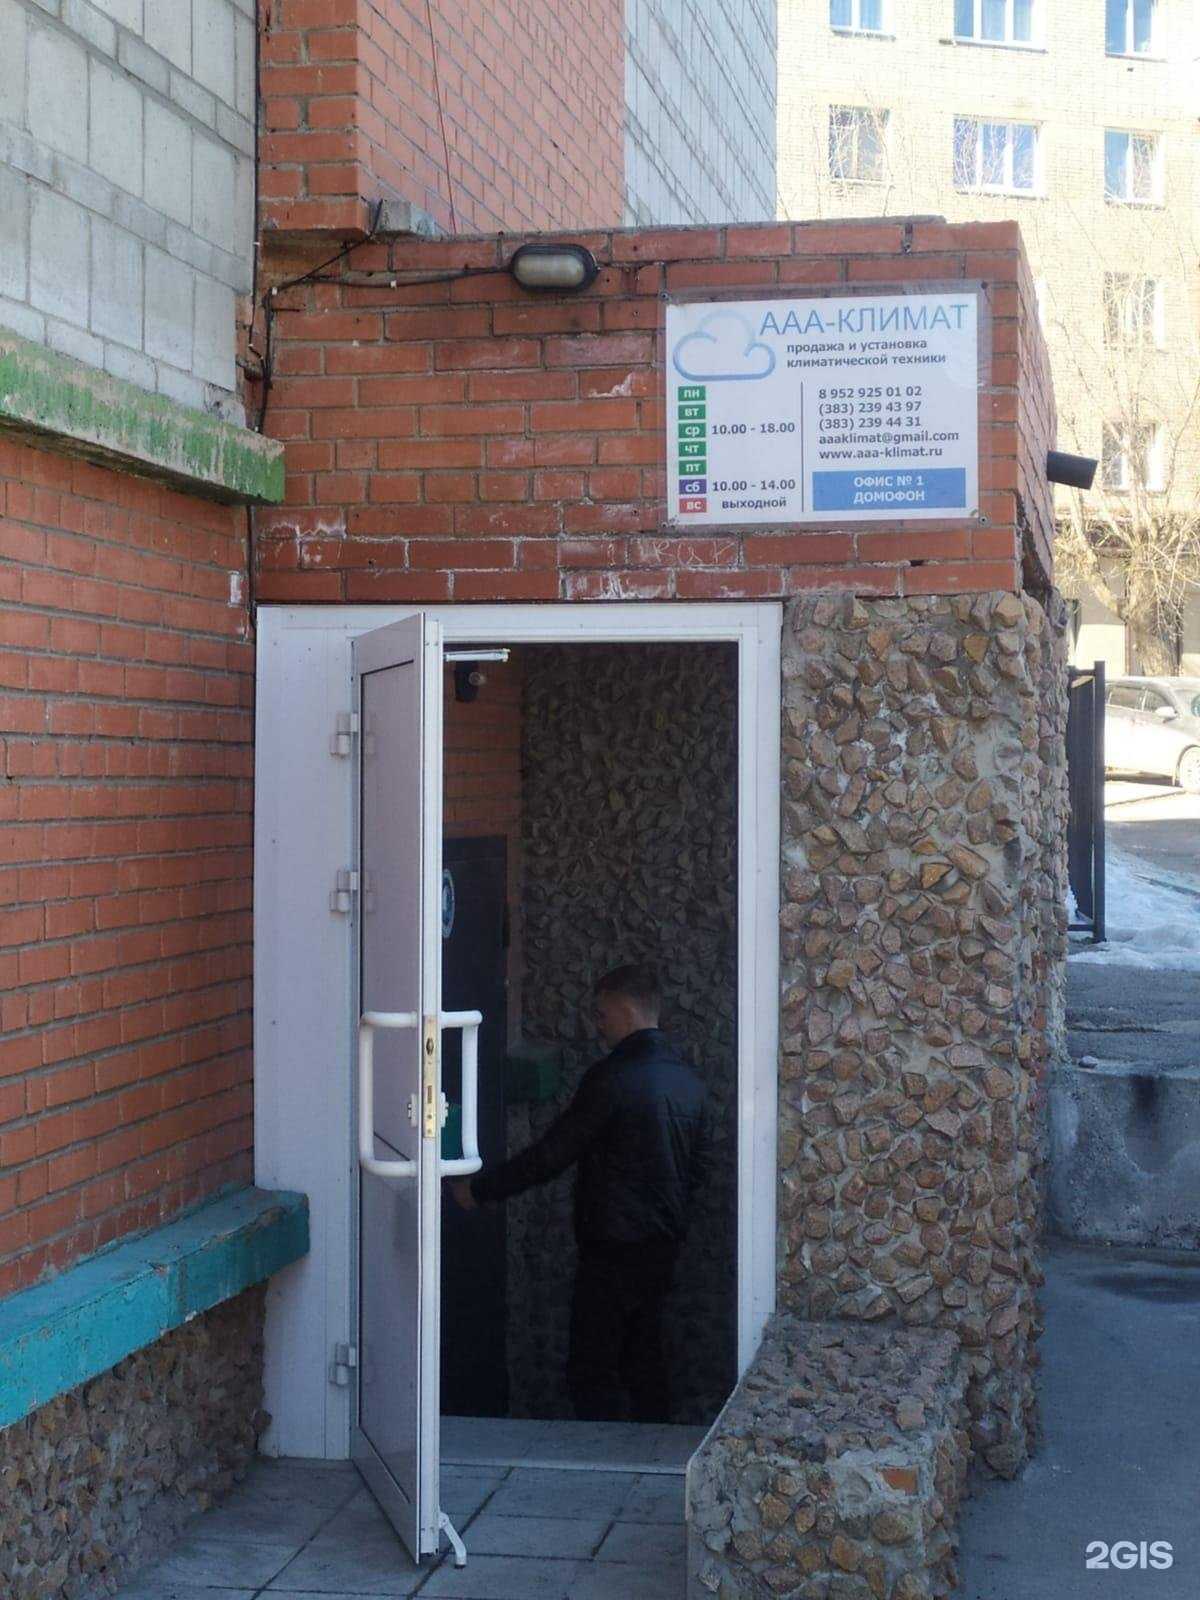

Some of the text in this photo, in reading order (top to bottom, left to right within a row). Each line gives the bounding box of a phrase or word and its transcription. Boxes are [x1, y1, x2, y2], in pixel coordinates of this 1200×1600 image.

[760, 304, 969, 336] ААА-КЛИМАТ
[787, 339, 928, 354] продажа и установка
[787, 354, 946, 368] климатической техники
[683, 389, 700, 399] пн
[819, 386, 922, 399] 8 952 925 01 02
[684, 407, 700, 417] вт
[819, 401, 922, 416] (383) 239 43 97
[685, 426, 700, 437] ср
[712, 424, 747, 435] 10.00
[760, 422, 795, 433] 18.00
[819, 416, 922, 431] (383) 239 44 31
[819, 430, 959, 445] aaaklimat@gmail.com
[685, 444, 700, 453] чт
[819, 447, 943, 459] www.aaa-klimat.ru
[685, 463, 701, 472] пт
[685, 481, 700, 493] сб
[712, 480, 748, 491] 10.00
[760, 479, 796, 490] 14.00
[854, 475, 925, 488] ОФИС № 1
[686, 497, 787, 510] вс выходной
[853, 491, 925, 504] ДОМОФОН
